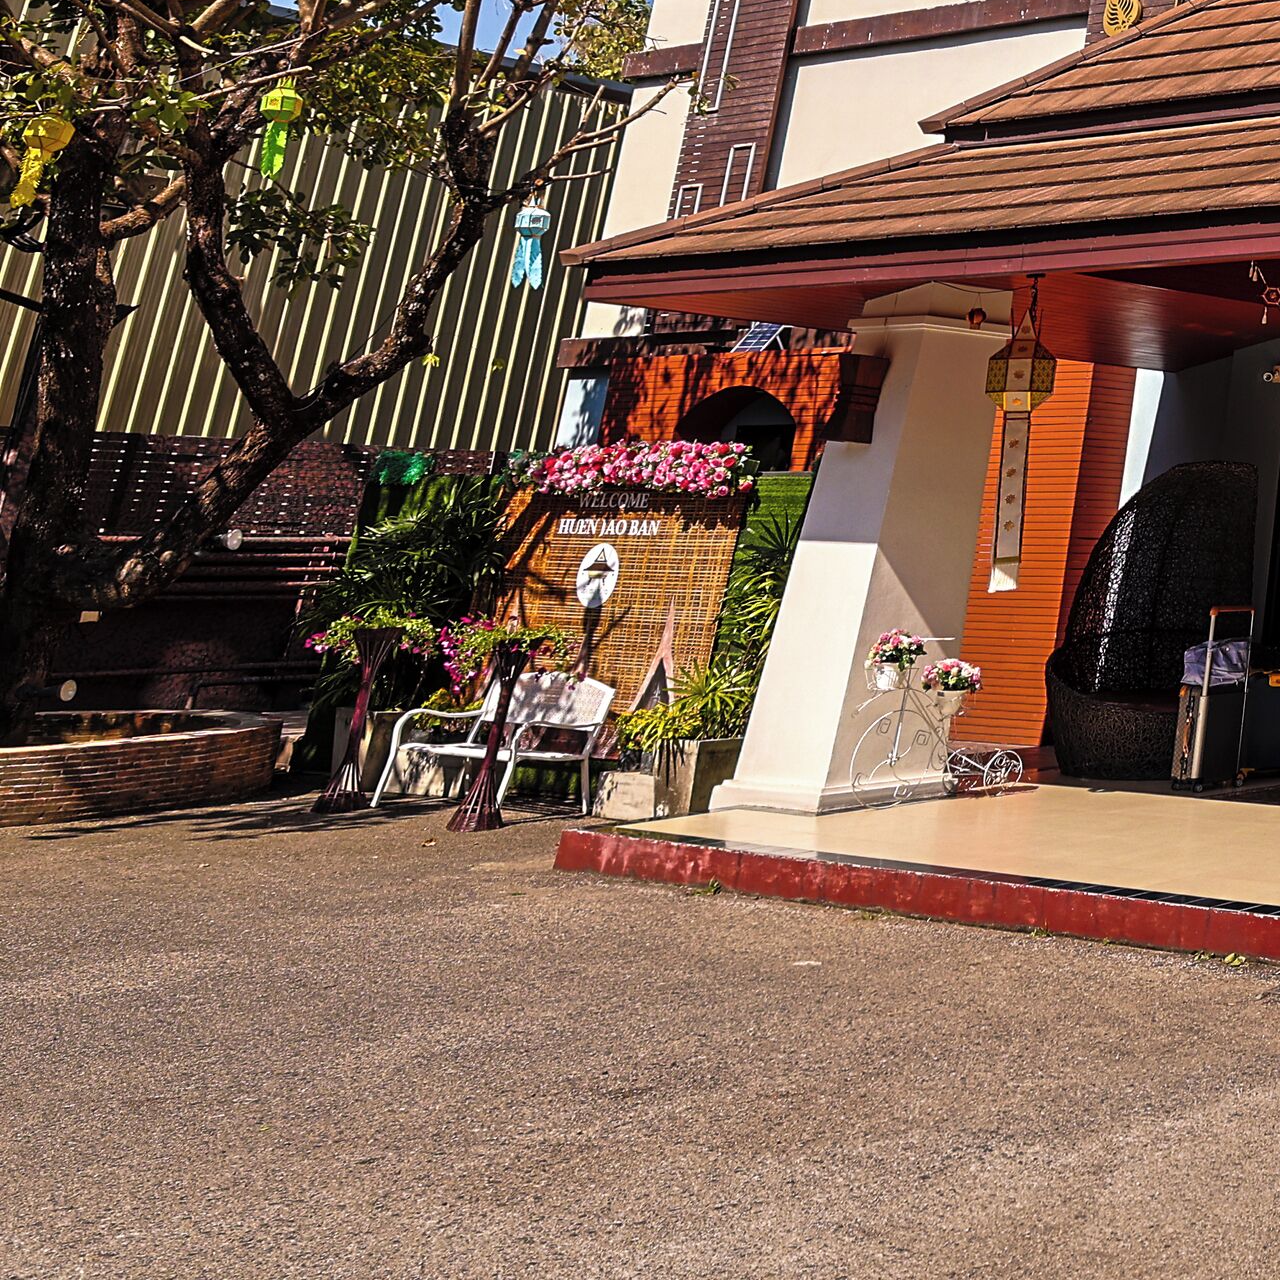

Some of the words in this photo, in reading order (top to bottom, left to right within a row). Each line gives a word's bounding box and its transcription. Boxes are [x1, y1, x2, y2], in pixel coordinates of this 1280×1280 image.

[579, 492, 651, 508] WELCOME
[557, 518, 599, 535] HUEN
[598, 518, 628, 537] JAO
[628, 519, 662, 536] BAN
